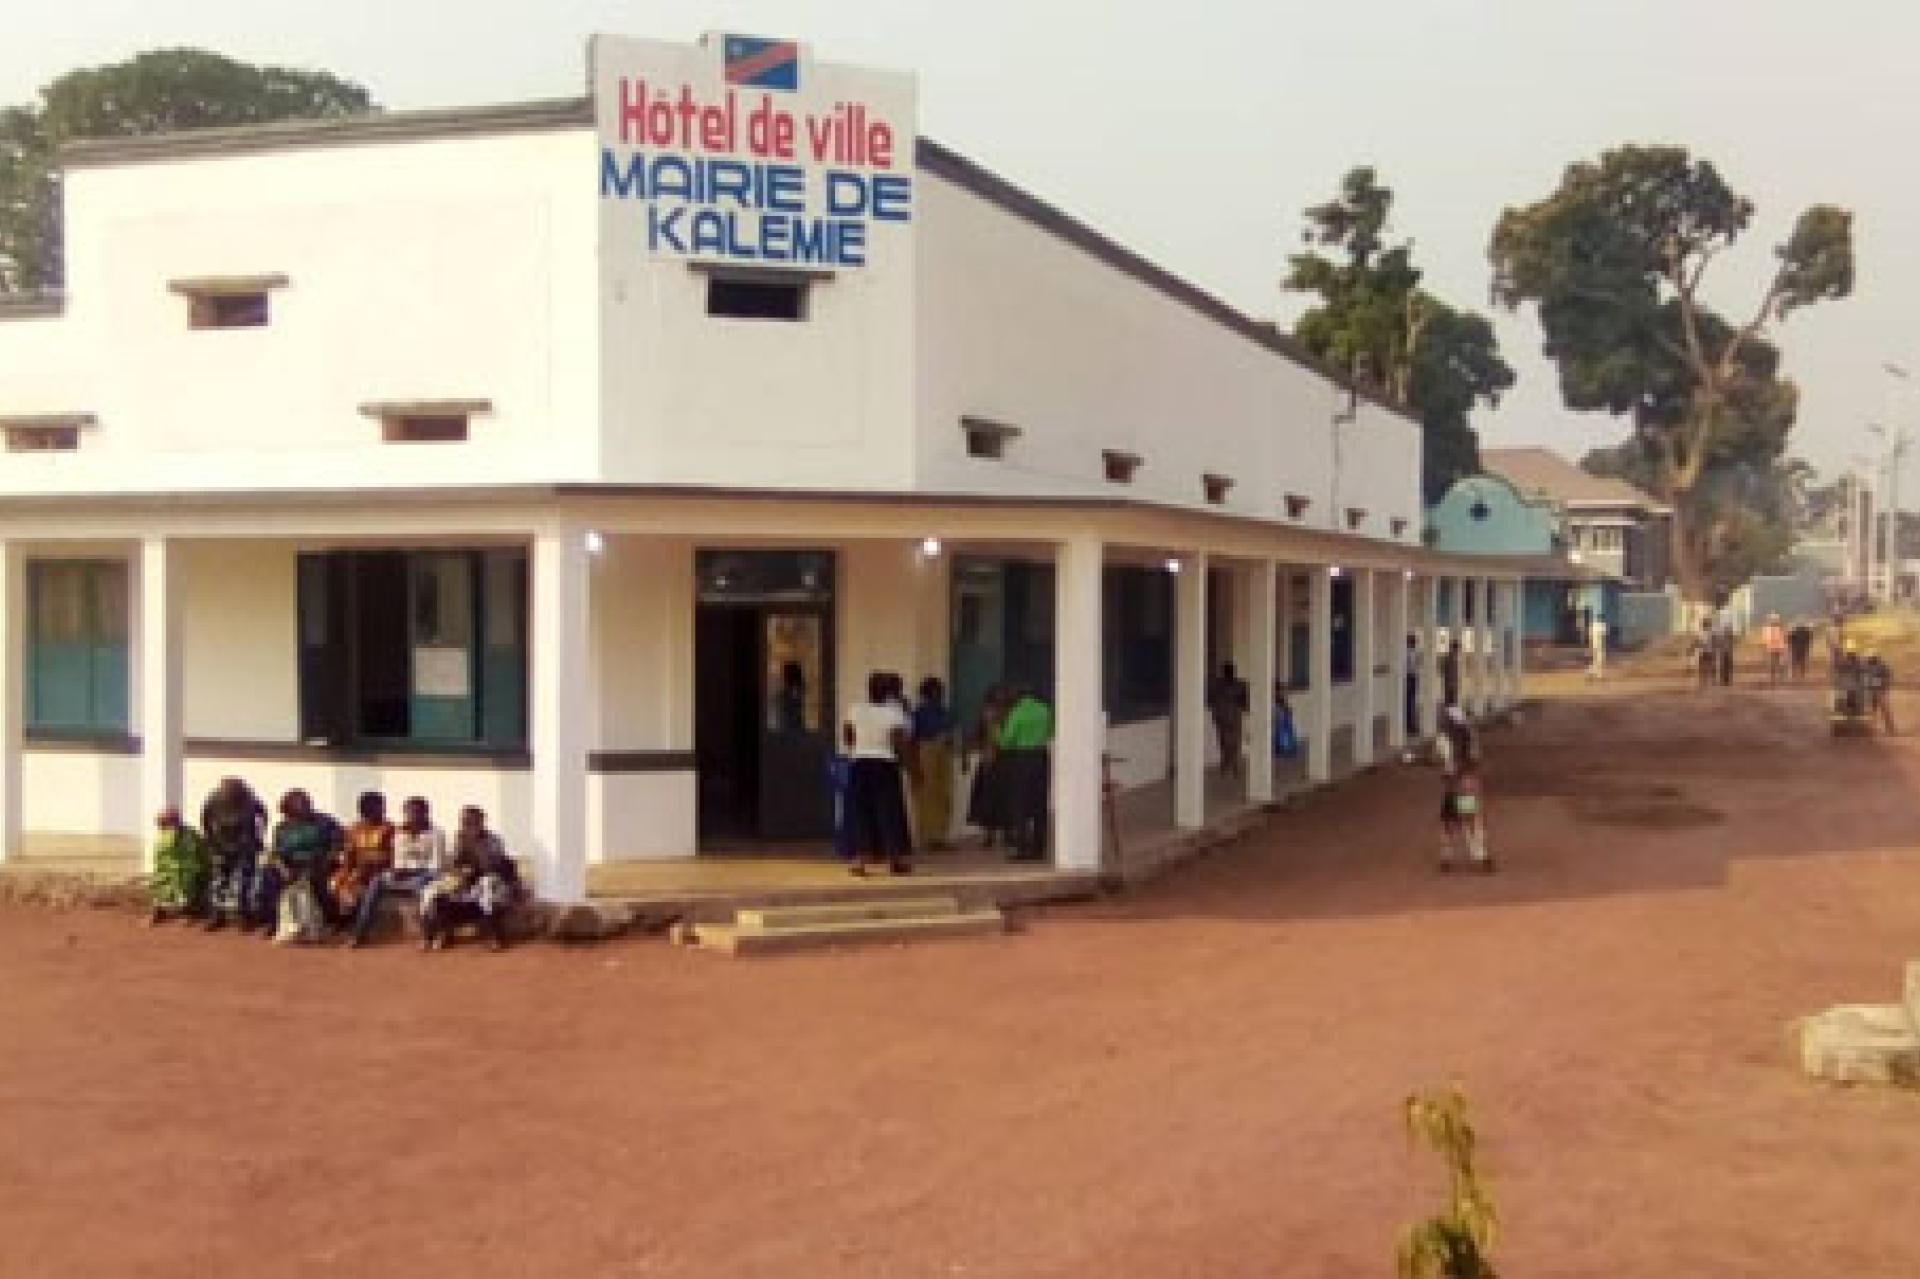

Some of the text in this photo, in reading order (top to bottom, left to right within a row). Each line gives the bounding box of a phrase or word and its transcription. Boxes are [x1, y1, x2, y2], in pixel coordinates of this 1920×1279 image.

[747, 94, 795, 159] de
[806, 102, 893, 168] ville
[601, 149, 912, 220] MAIRIE DE
[649, 205, 866, 265] KALEMIE
